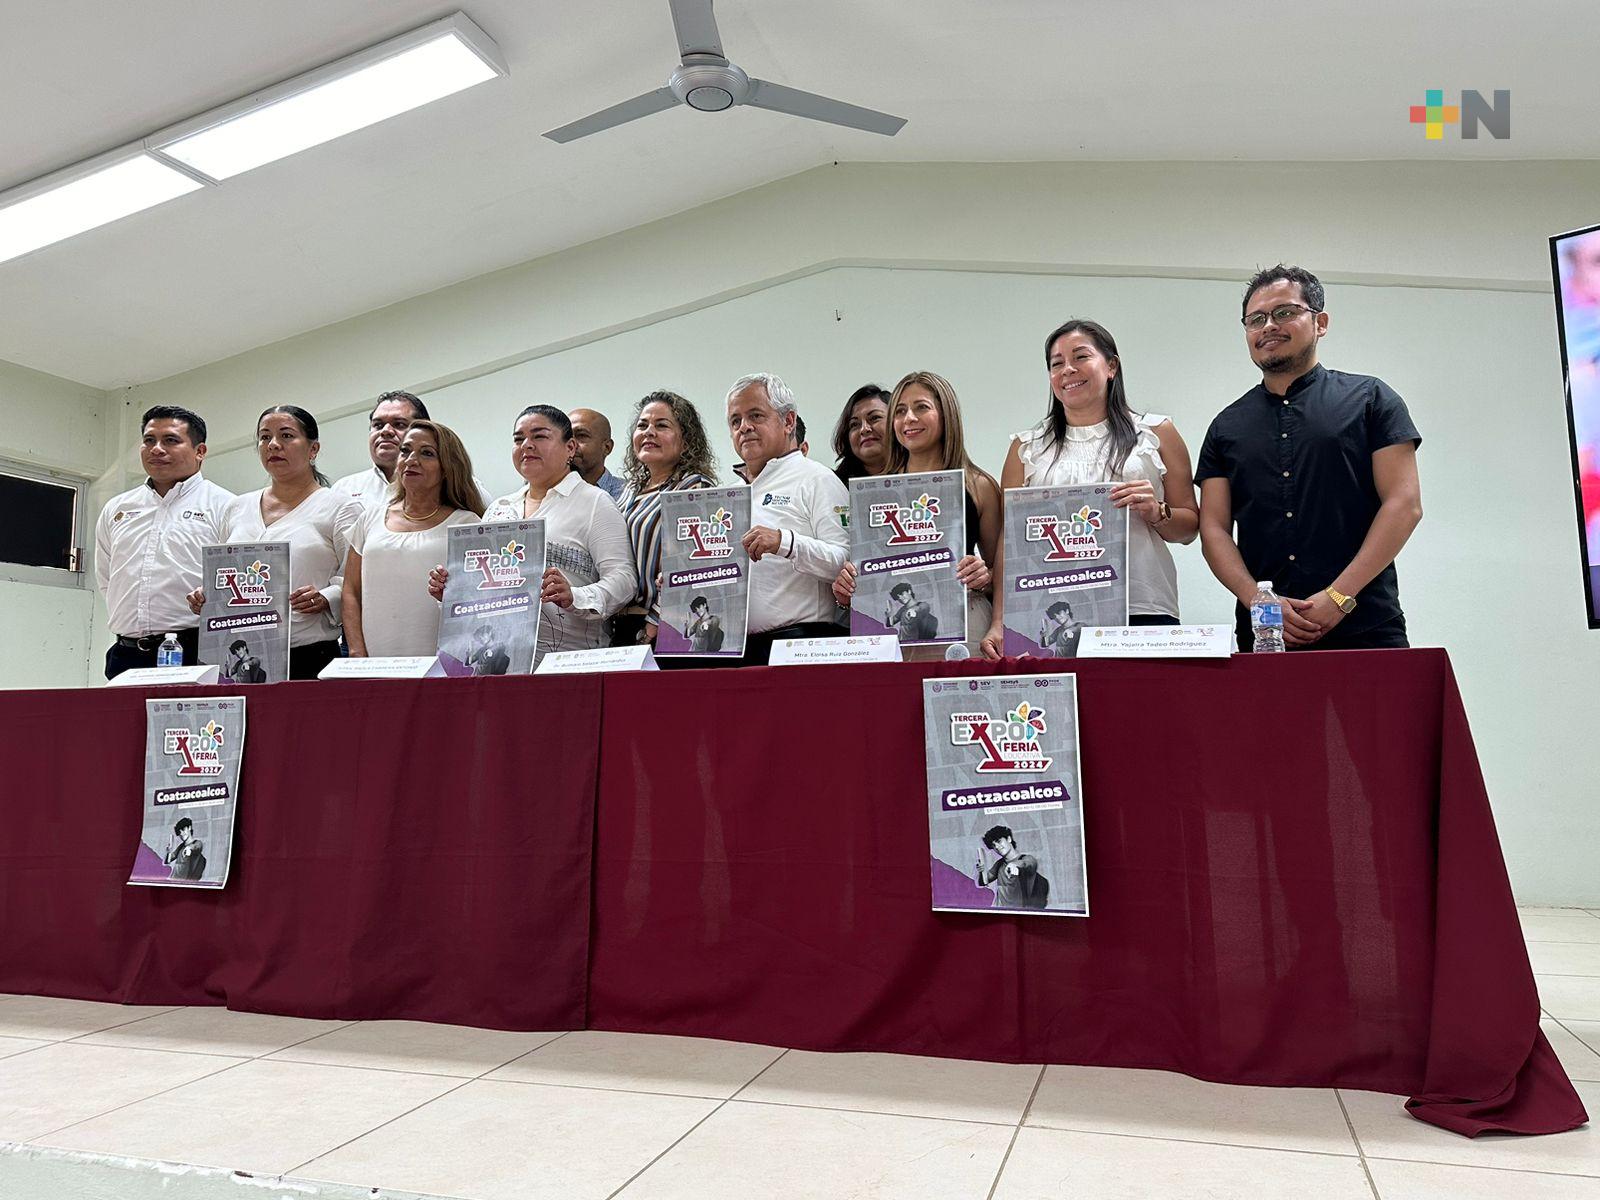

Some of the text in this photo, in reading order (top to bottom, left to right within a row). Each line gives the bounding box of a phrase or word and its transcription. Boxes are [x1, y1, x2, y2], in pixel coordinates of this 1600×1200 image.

[871, 509, 926, 525] EXPO
[678, 522, 720, 538] EXPO
[907, 522, 934, 530] FERIA
[1028, 521, 1085, 539] EXPO
[705, 536, 727, 544] FERIA
[914, 534, 937, 542] 2024
[1066, 537, 1095, 545] FERIA
[864, 551, 950, 572] Coatzacoalcos
[1074, 550, 1098, 558] 2024
[466, 555, 512, 570] EXPO
[495, 567, 519, 576] FERIA
[671, 565, 738, 585] Coatzacoalcos
[1019, 569, 1112, 589] Coatzacoalcos
[216, 573, 258, 586] EXPO
[454, 595, 529, 615] Coatzacoalcos
[209, 613, 278, 629] Coatzacoalcos
[953, 722, 1025, 742] EXPO
[165, 736, 211, 751] EXPO
[1003, 742, 1039, 752] FERIA
[195, 752, 217, 760] FERIA
[200, 766, 218, 774] 2024
[1013, 761, 1043, 769] 2024
[156, 786, 226, 803] Coatzacoalcos
[946, 785, 1063, 807] Coatzacoalcos
